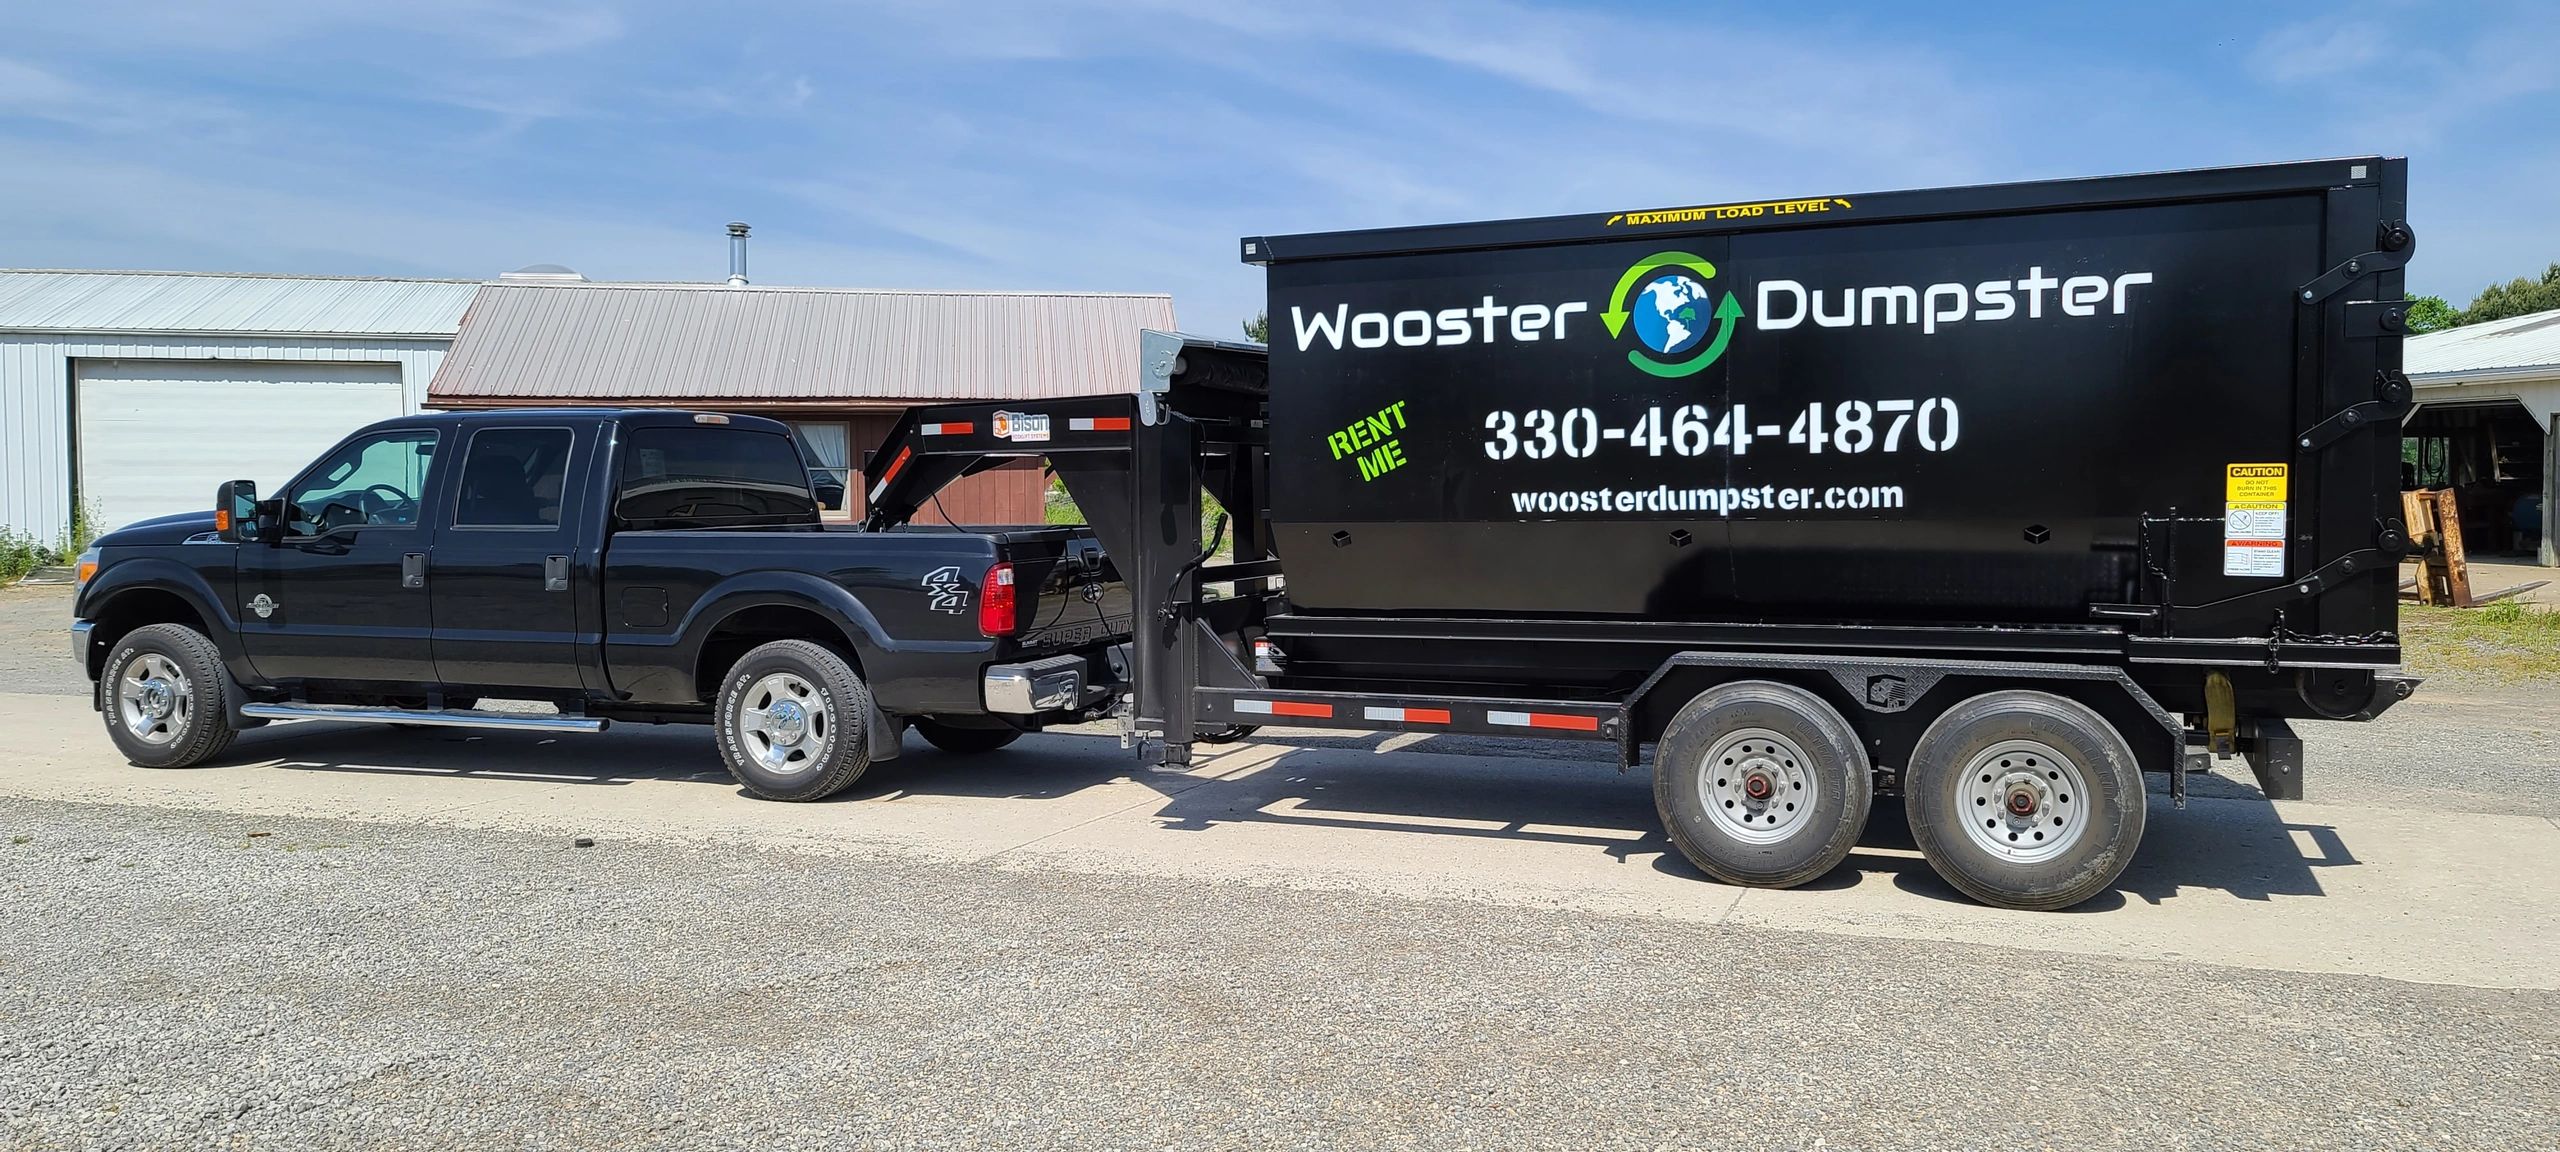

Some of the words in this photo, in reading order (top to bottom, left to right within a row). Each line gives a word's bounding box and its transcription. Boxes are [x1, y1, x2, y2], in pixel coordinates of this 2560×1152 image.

[1627, 211, 1706, 225] MAXIMUM
[1716, 207, 1764, 219] LOAD
[1774, 202, 1830, 215] LEVEL
[1291, 296, 1588, 352] Wooster
[1756, 266, 2154, 335] Dumpster
[1011, 414, 1048, 431] Bison
[1328, 400, 1406, 460] RENT
[1484, 397, 1959, 460] 330-464-4870
[1357, 439, 1407, 481] ME
[2232, 467, 2283, 476] CAUTION
[1511, 484, 1904, 517] woosterdumpster.com
[1042, 625, 1093, 648] SUPER
[105, 658, 122, 726] TRANSFORCE
[724, 690, 745, 767] TRANSFORCE
